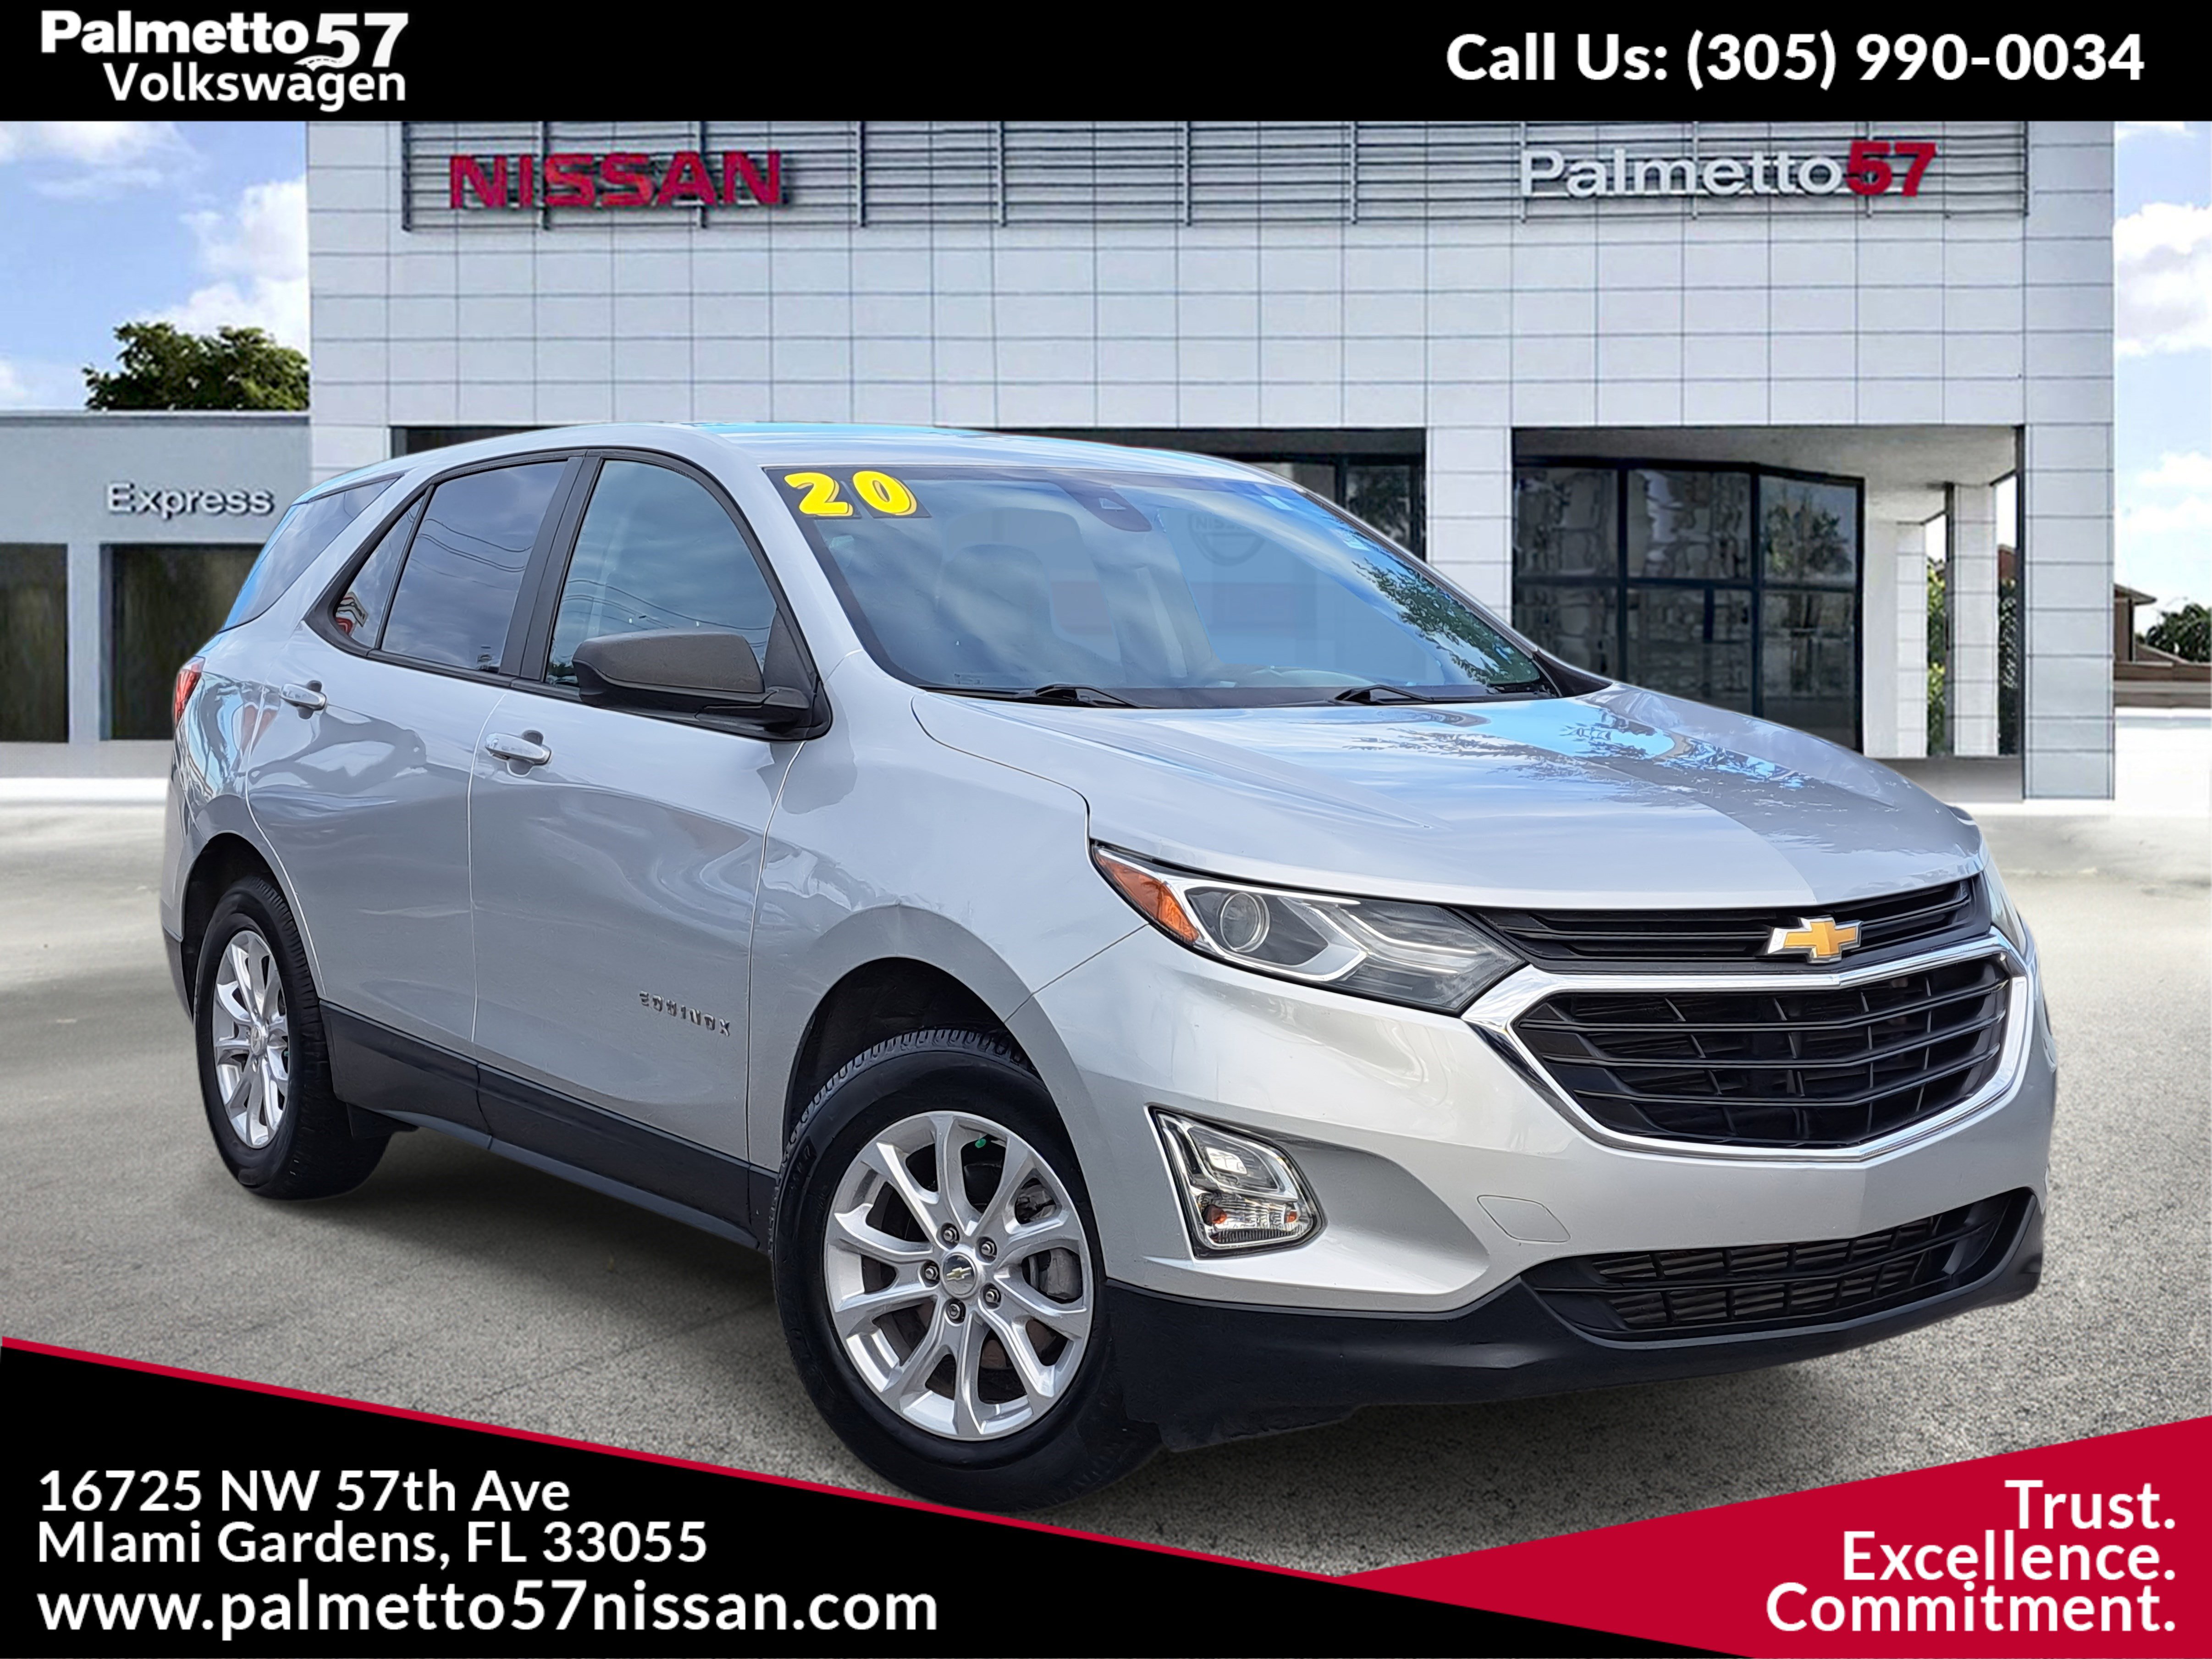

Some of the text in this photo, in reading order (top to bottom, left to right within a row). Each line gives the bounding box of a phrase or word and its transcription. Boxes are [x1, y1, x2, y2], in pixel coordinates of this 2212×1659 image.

[450, 150, 781, 209] NISSAN
[107, 482, 275, 519] Express
[784, 470, 917, 517] 20
